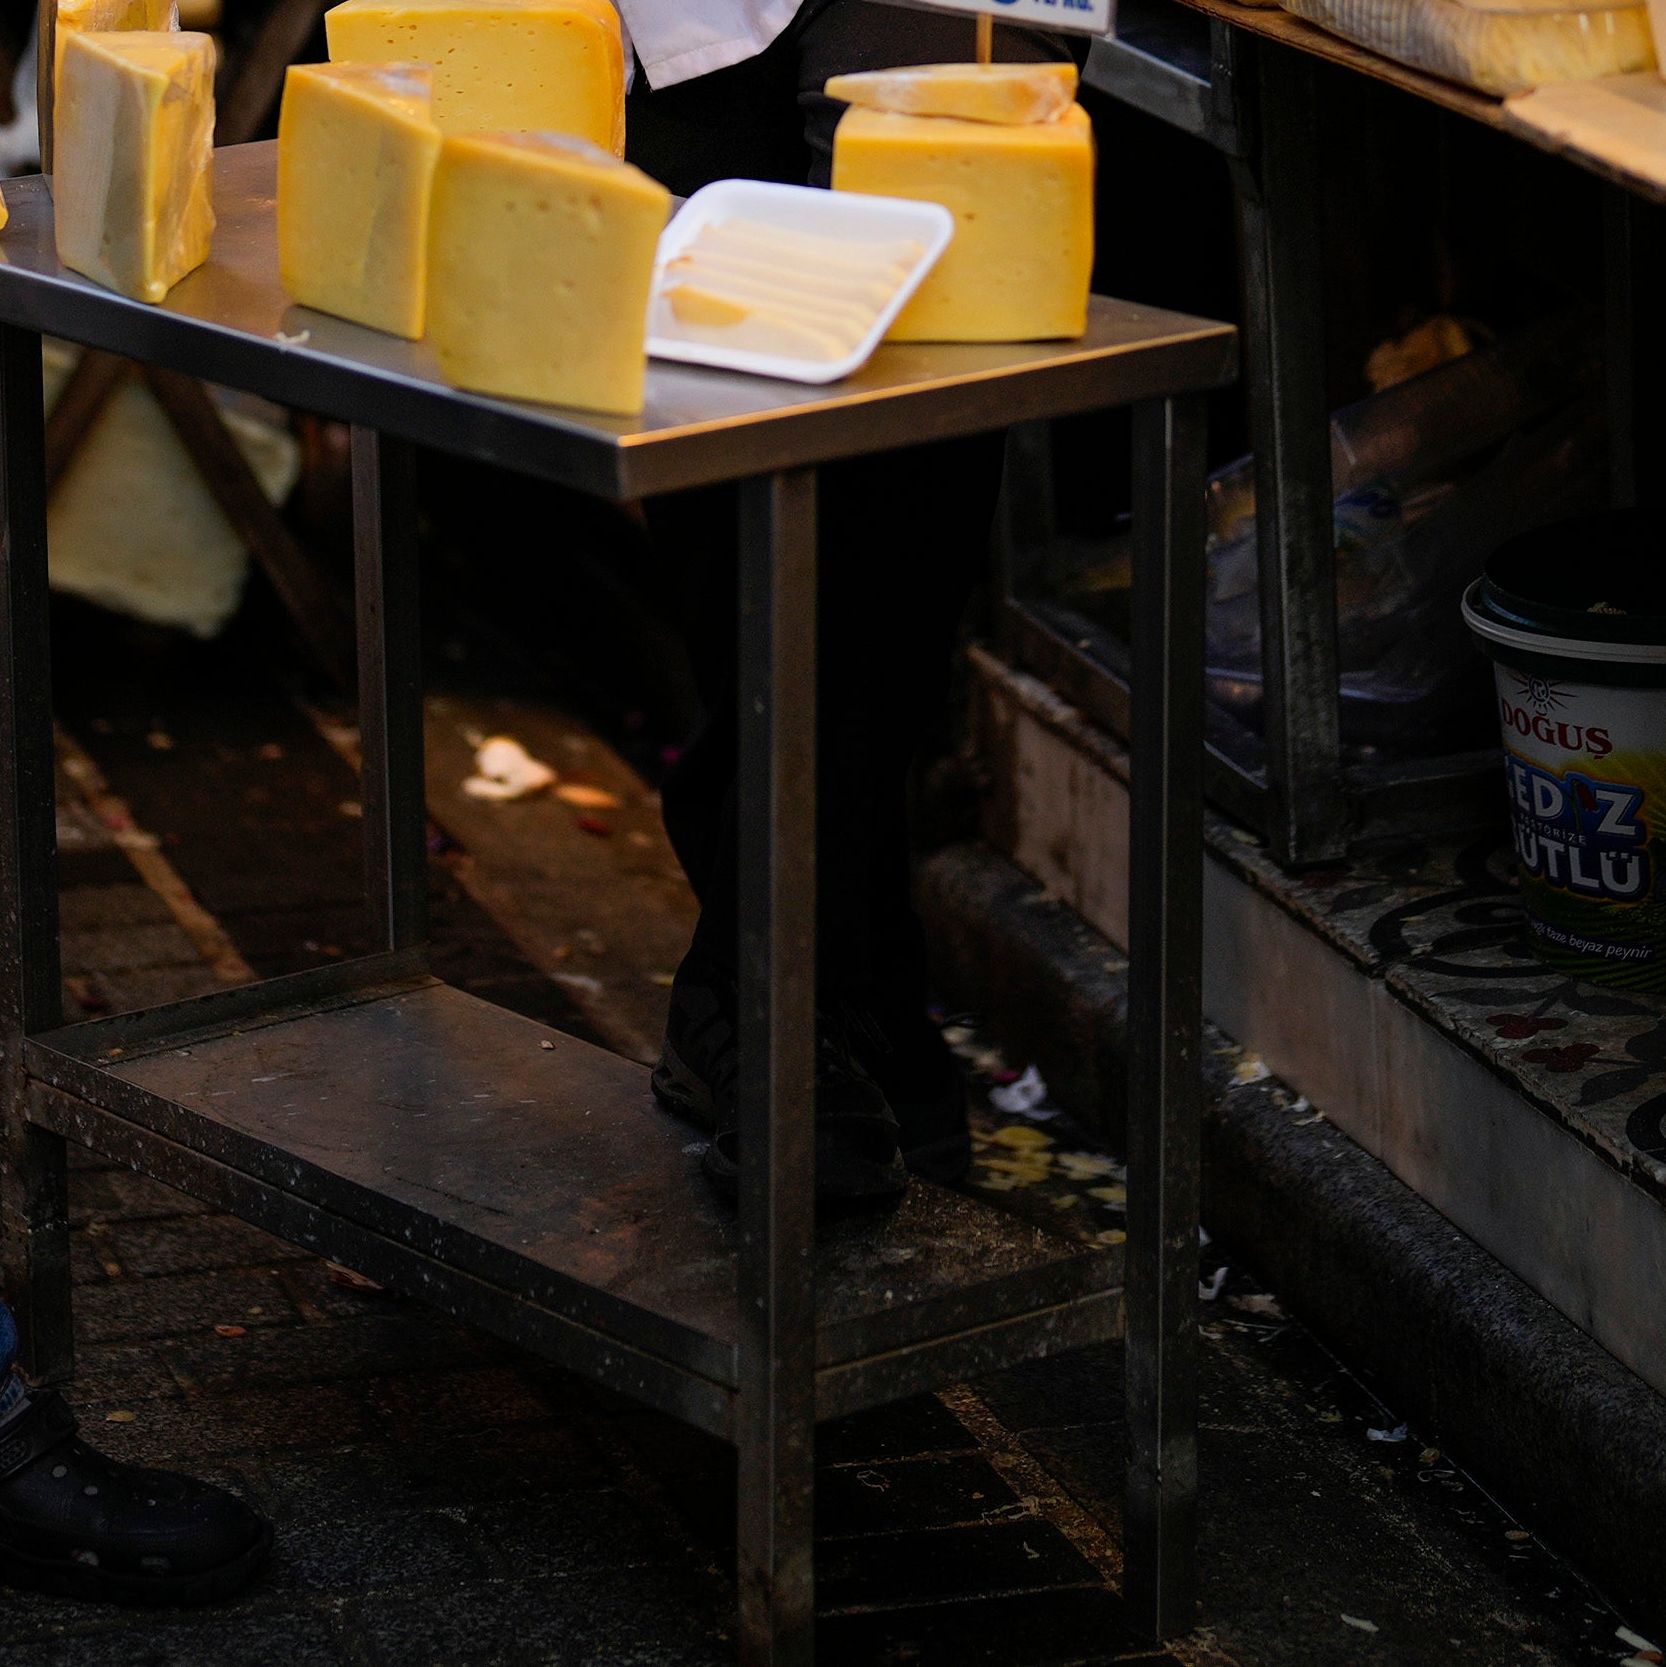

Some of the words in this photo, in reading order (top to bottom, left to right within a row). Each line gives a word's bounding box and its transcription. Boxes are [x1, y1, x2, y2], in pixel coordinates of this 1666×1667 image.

[1500, 697, 1613, 760] DOĞUŞ
[1514, 822, 1641, 894] ÜTLÜ
[1568, 935, 1604, 953] beyaz
[1605, 945, 1653, 961] peynir
